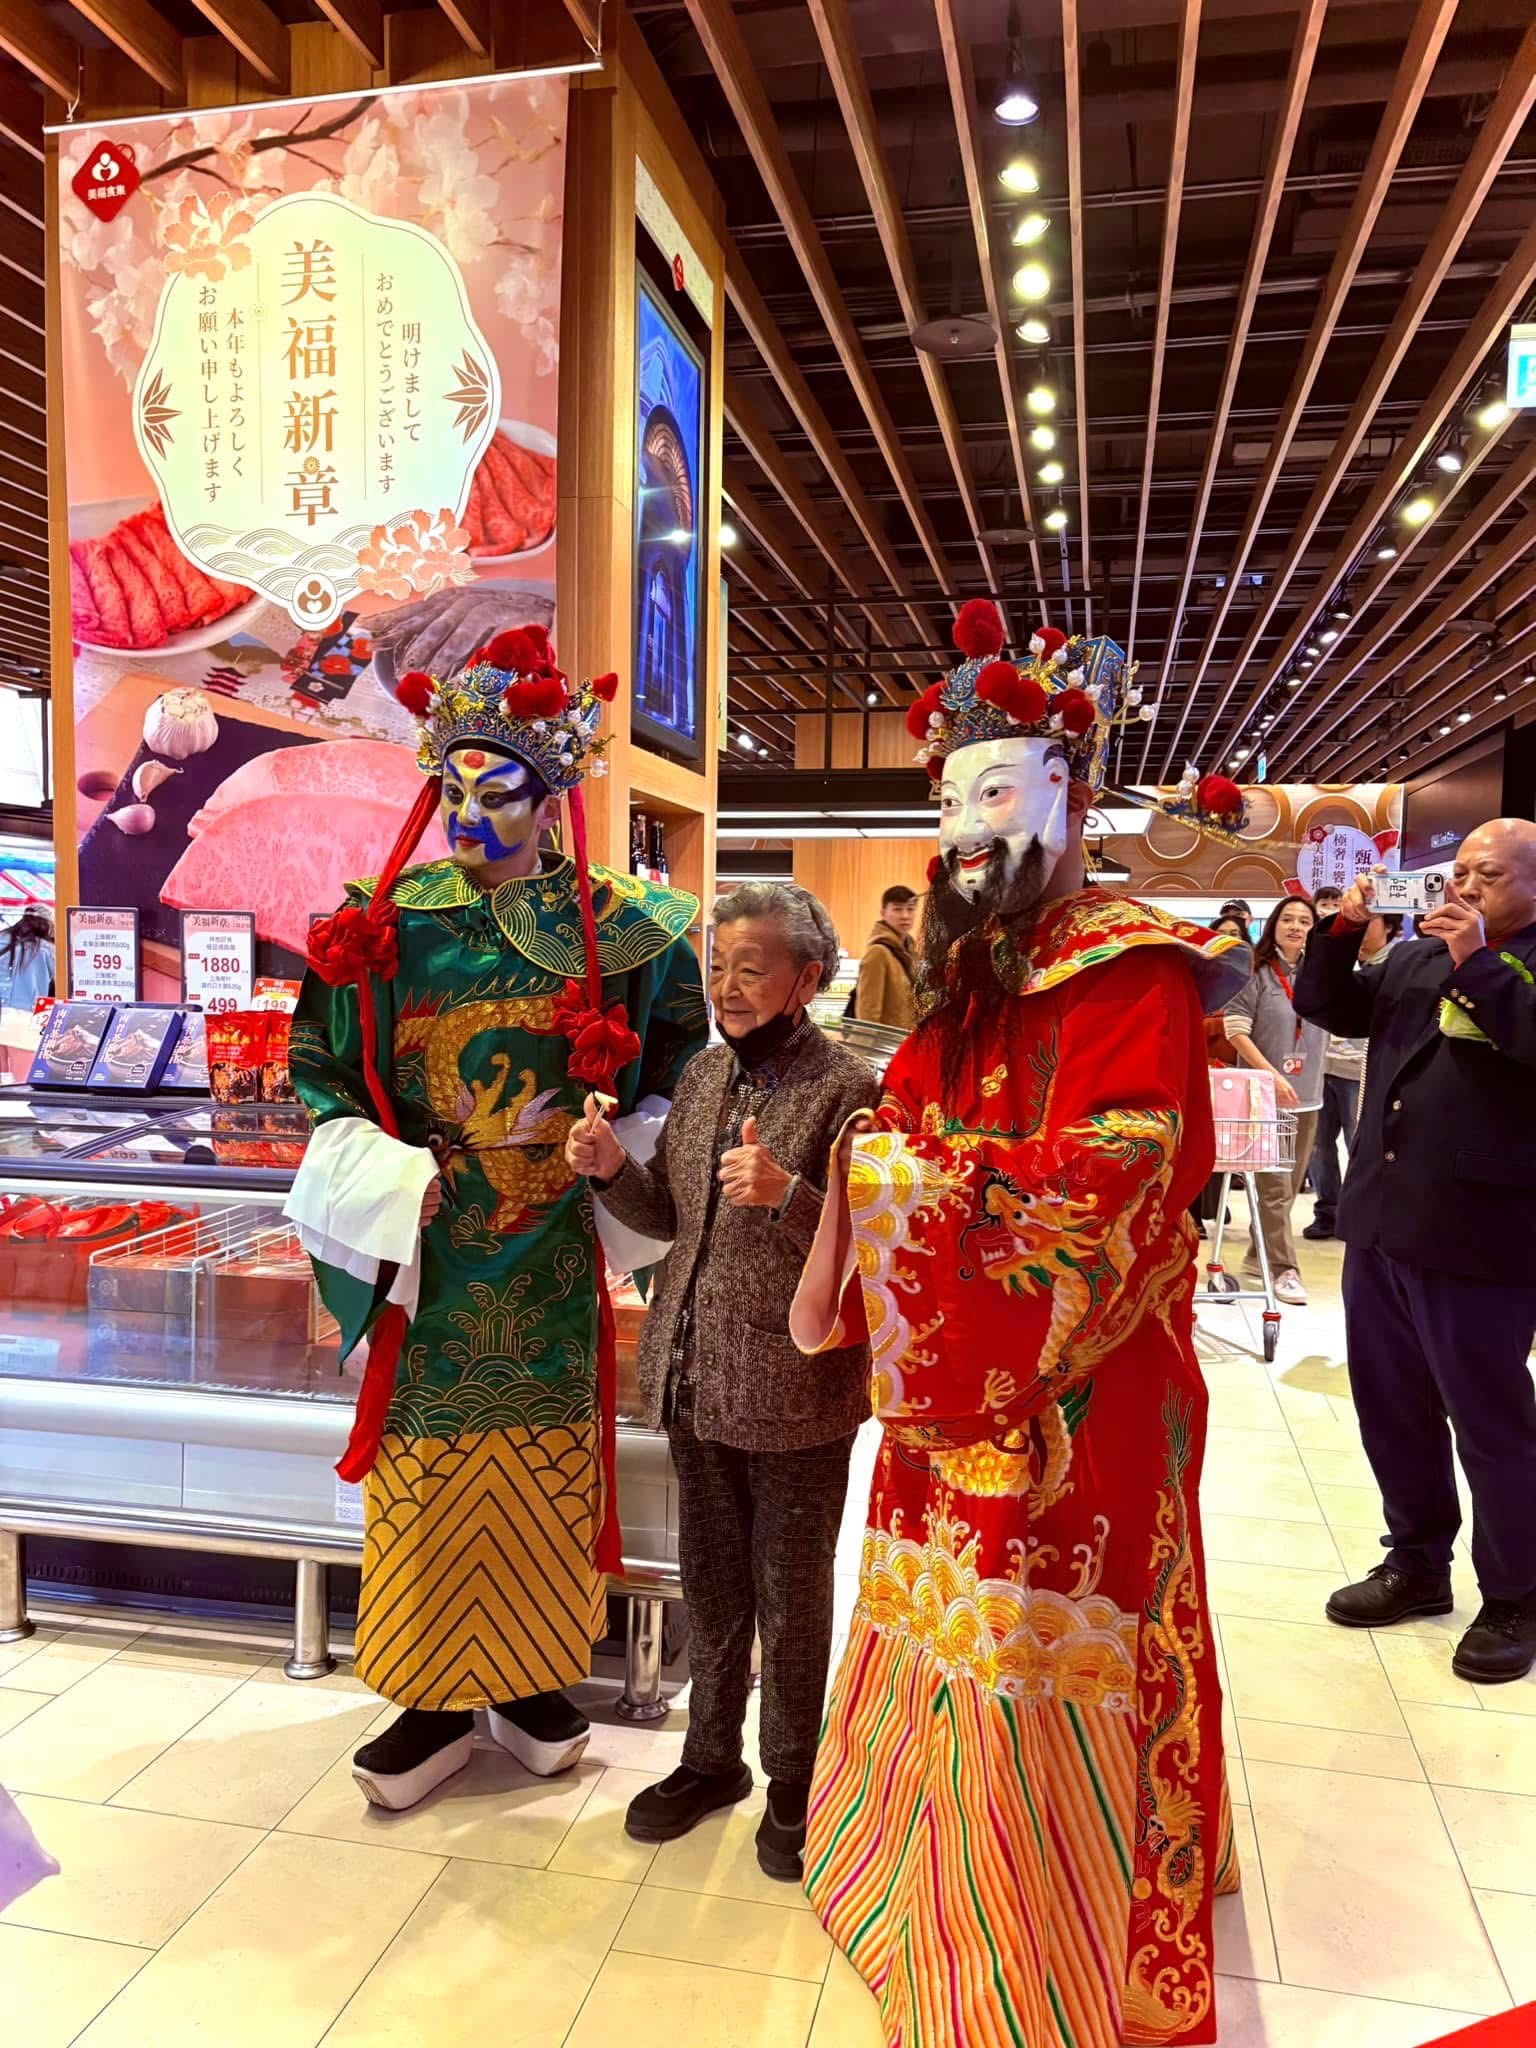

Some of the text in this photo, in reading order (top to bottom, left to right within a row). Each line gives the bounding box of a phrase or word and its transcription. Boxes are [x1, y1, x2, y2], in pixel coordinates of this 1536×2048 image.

[198, 286, 222, 503] お願い申し上げます
[225, 307, 246, 477] 本年もよろしく
[281, 237, 340, 526] 美福新章
[376, 273, 395, 494] おめでとうございます
[402, 322, 422, 442] 明けまして
[93, 954, 122, 970] 599
[200, 957, 240, 973] 1880
[207, 997, 238, 1013] 499
[263, 999, 288, 1012] 199
